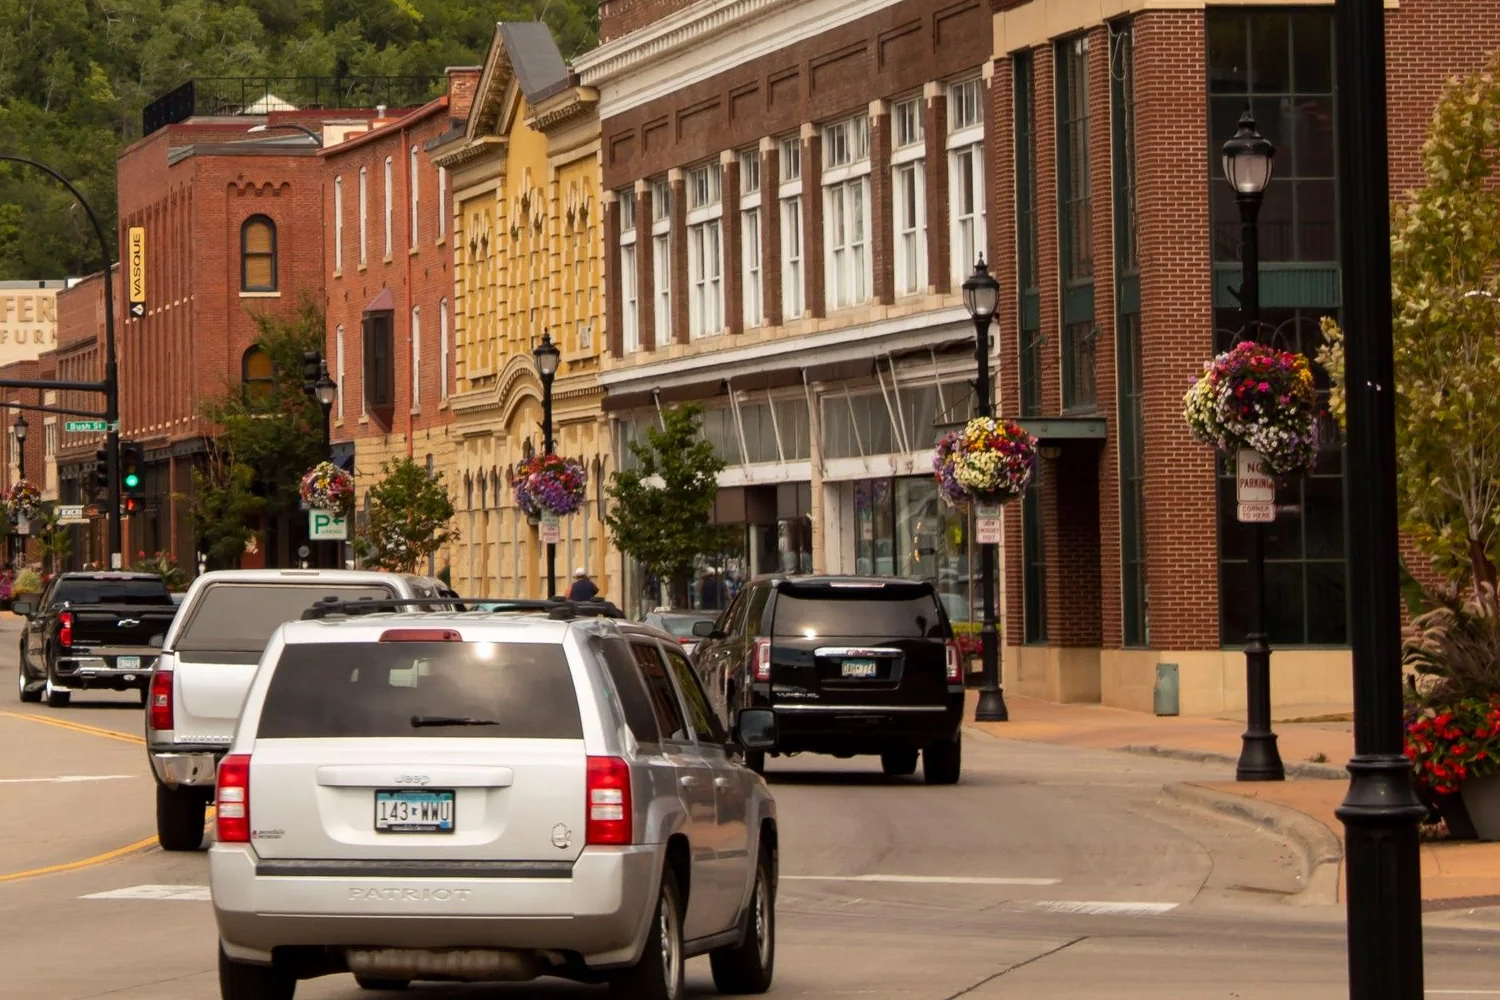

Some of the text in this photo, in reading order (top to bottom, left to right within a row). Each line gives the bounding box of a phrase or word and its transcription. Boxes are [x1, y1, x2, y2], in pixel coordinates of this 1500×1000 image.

[133, 233, 141, 297] VASQUE
[70, 421, 102, 431] Bush St
[394, 775, 430, 786] Jeep
[380, 801, 449, 821] 143 WWU
[347, 887, 473, 901] PATRIOT
